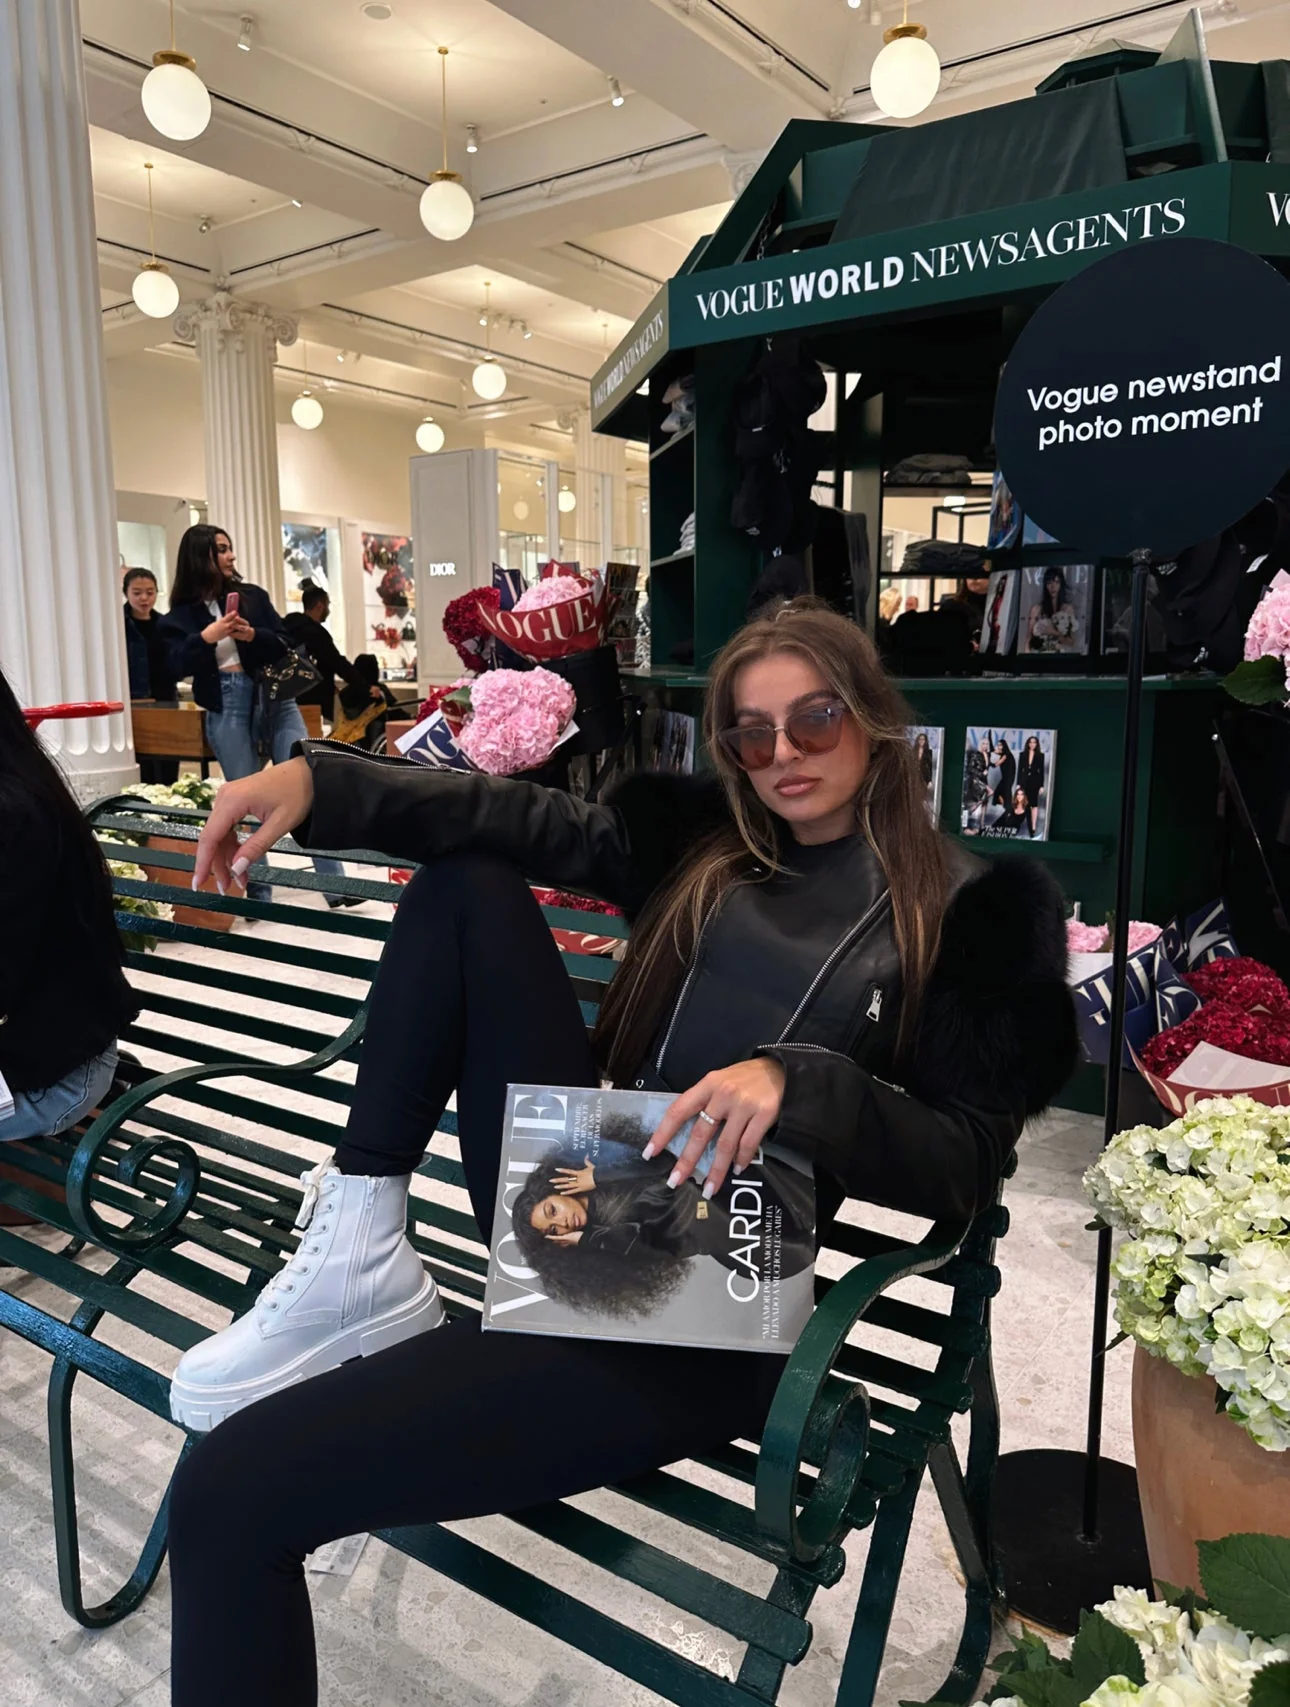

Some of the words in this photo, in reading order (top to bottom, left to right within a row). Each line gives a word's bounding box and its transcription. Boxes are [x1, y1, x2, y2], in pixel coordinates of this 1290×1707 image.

[696, 278, 784, 321] VOGUE
[789, 256, 905, 305] WORLD
[910, 197, 1186, 283] NEWSAGENTS
[1026, 382, 1119, 414] Vogue
[1128, 355, 1282, 400] newstand
[1038, 415, 1123, 451] photo
[1131, 396, 1264, 436] moment
[429, 562, 456, 577] DIOR
[476, 595, 597, 645] VOGUE
[764, 1219, 773, 1233] ME
[765, 1205, 774, 1218] HA
[726, 1179, 764, 1303] CARDI
[764, 1234, 773, 1261] MODA
[764, 1262, 771, 1275] LA
[772, 1249, 781, 1287] MUCHOS
[763, 1276, 771, 1294] POR
[762, 1295, 771, 1321] AMOR
[770, 1297, 780, 1339] LLEVADO
